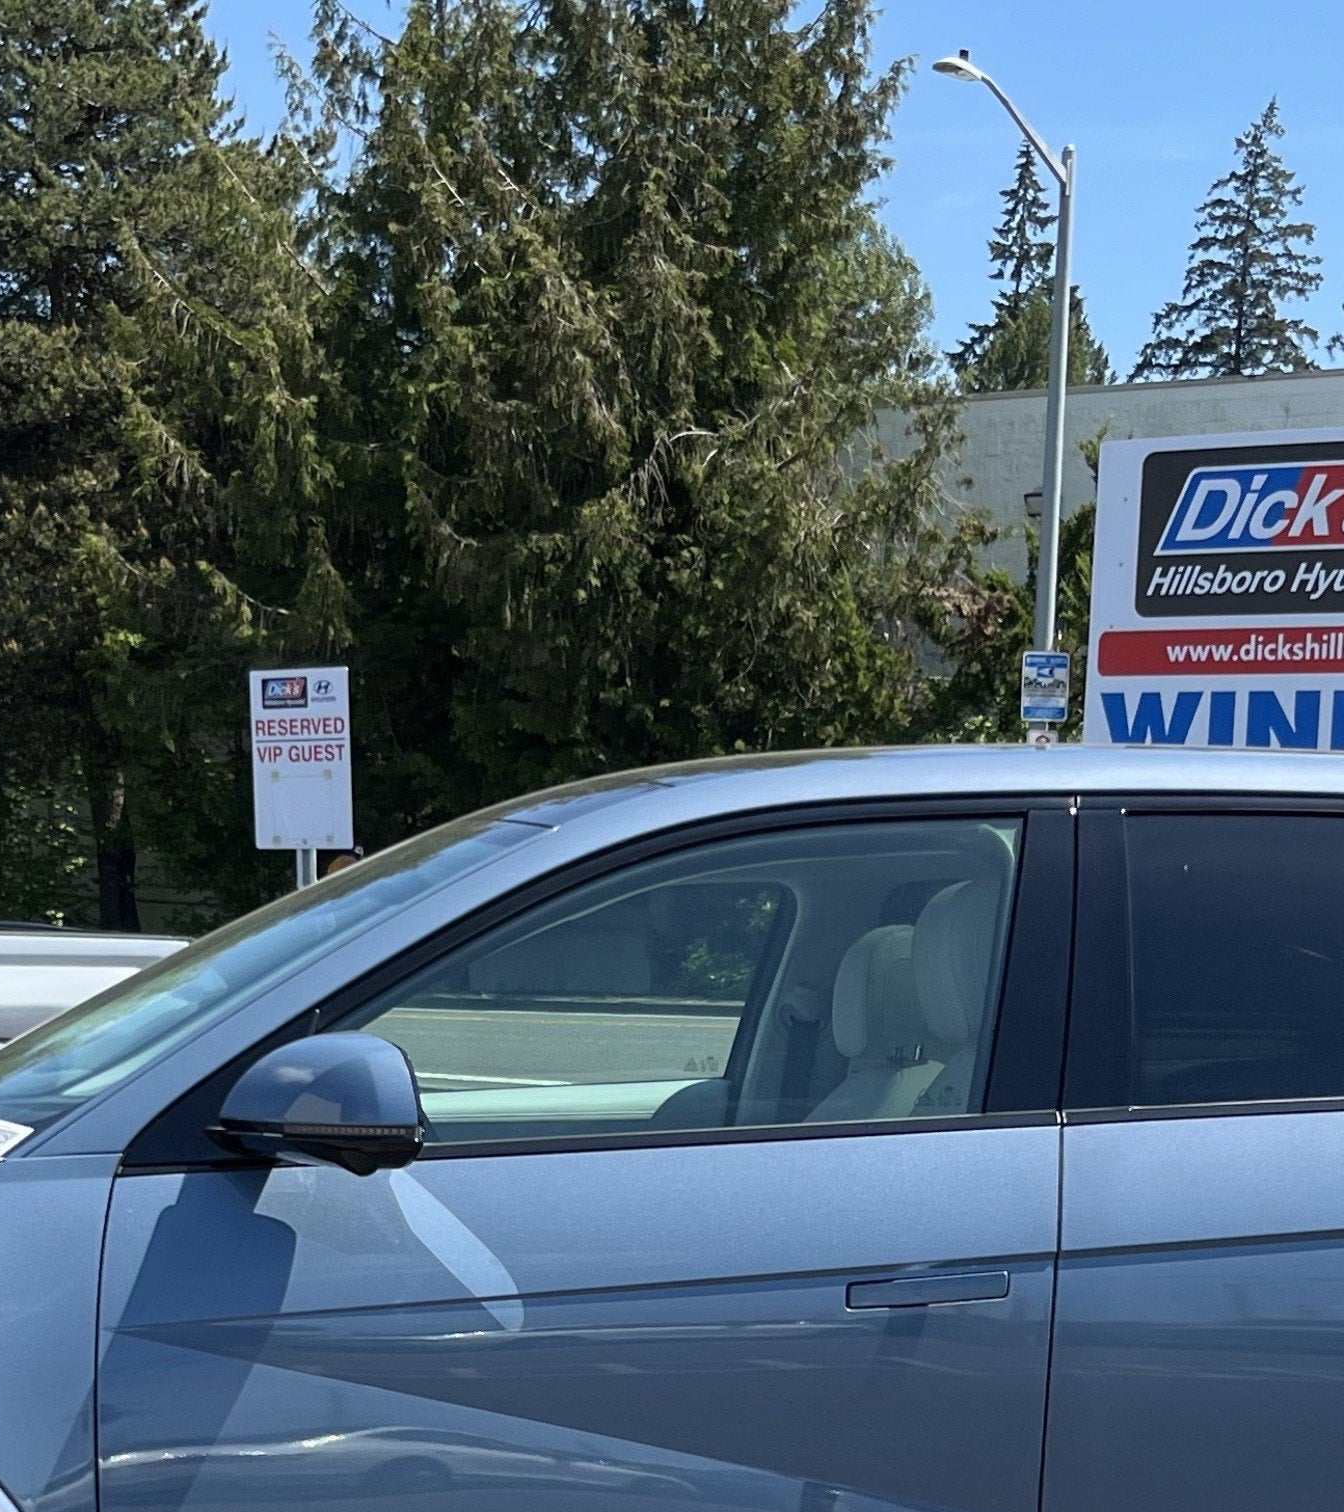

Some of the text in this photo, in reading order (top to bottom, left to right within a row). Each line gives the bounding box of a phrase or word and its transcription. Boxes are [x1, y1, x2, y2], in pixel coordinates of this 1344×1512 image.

[1146, 564, 1286, 597] Hillsboro
[255, 717, 345, 736] RESERVED
[257, 743, 346, 763] VIP GUEST
